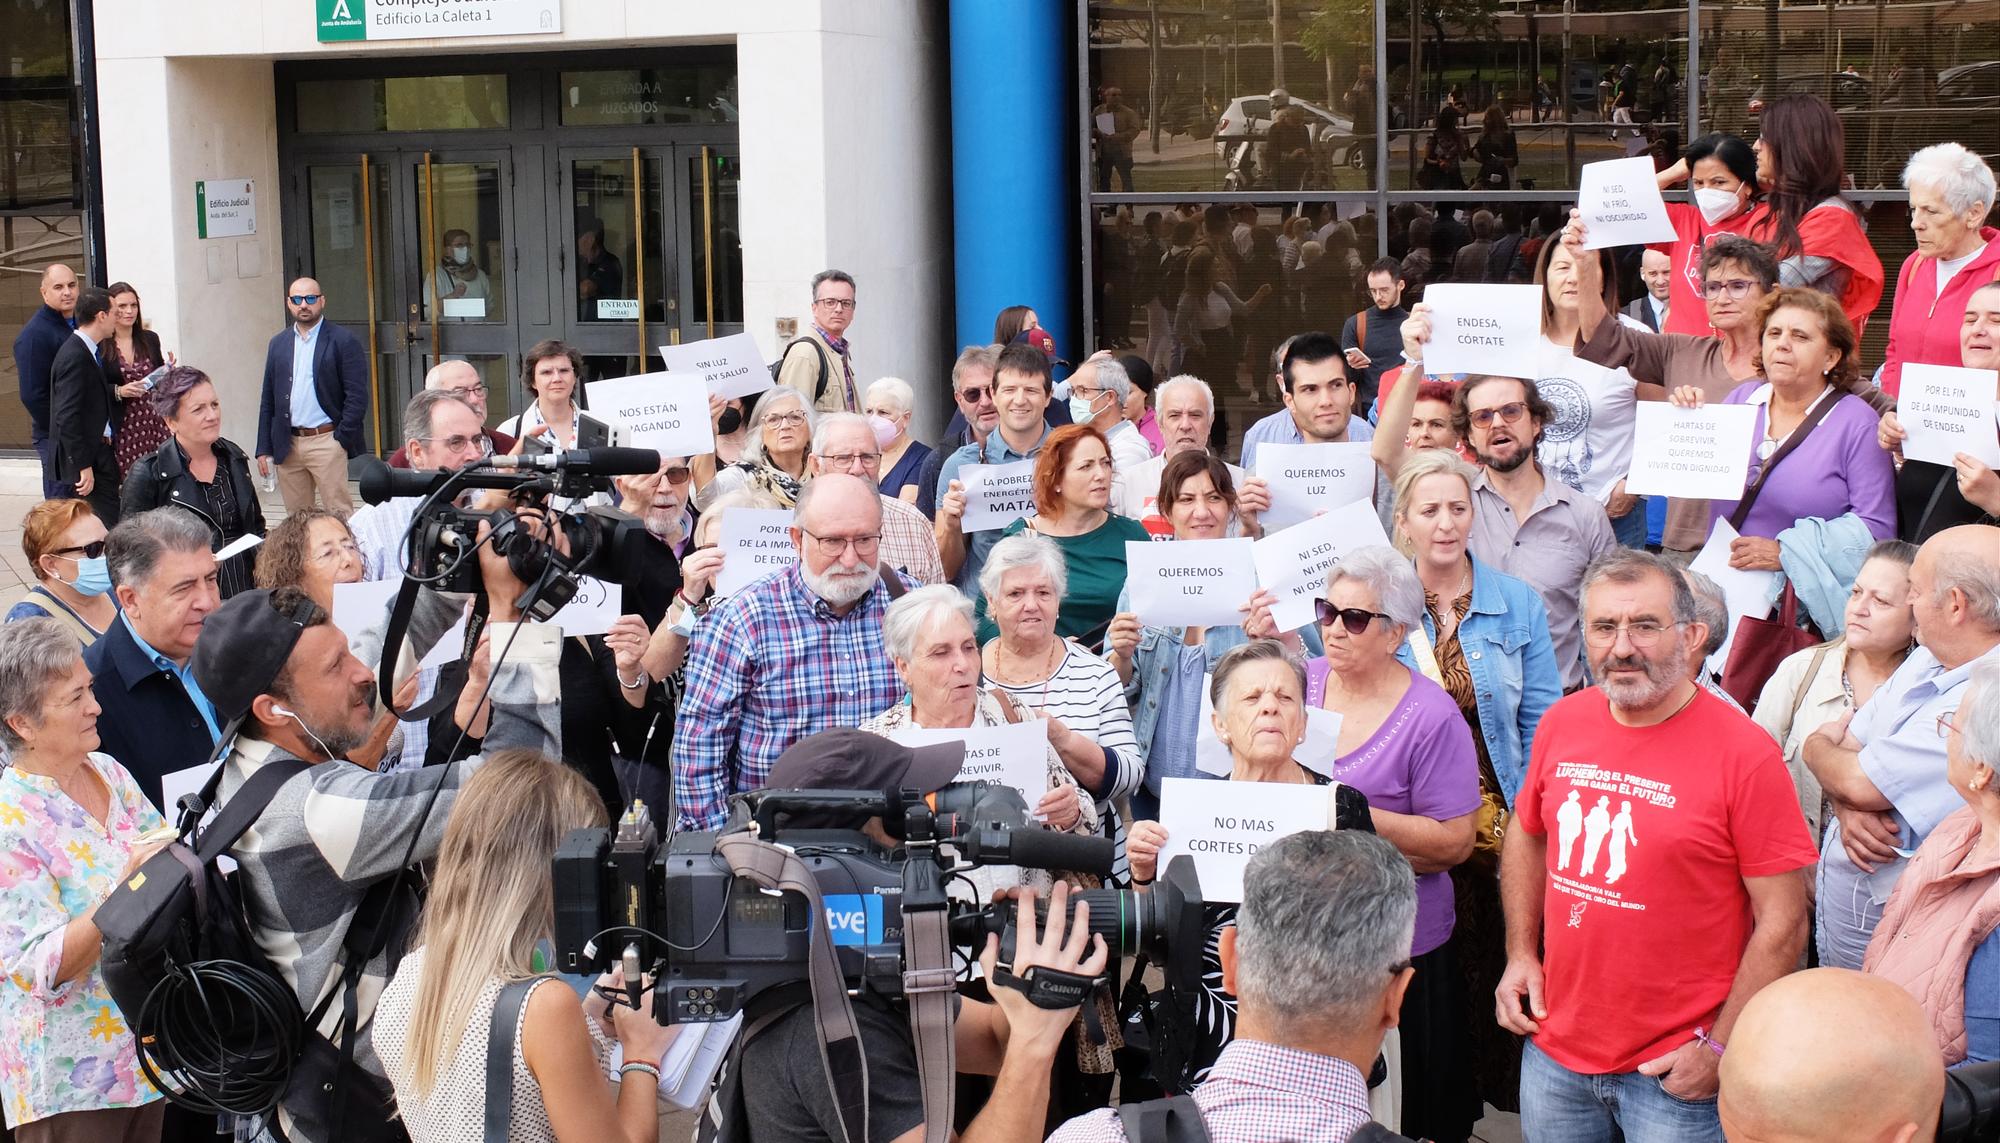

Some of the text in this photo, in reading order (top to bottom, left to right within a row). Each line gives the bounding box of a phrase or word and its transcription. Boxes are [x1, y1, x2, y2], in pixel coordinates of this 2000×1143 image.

[376, 9, 493, 25] Edificio La Caleta 1
[601, 82, 662, 96] ENTRADA A
[600, 101, 658, 114] JUZGADOS
[1605, 212, 1647, 222] OSCURIDAD
[1457, 317, 1502, 330] ENDESA,
[1457, 333, 1504, 346] CÓRTATE
[696, 358, 728, 369] SIN LUZ
[720, 367, 749, 380] SALUD
[1925, 385, 1966, 398] POR EL FIN
[619, 402, 678, 418] NOS ESTÁN
[1911, 401, 1981, 419] DE LA IMPUNIDAD
[1673, 421, 1717, 430] HARTAS DE
[1923, 419, 1965, 433] DE ENDESA
[1668, 448, 1714, 459] QUEREMOS
[1284, 468, 1346, 479] QUEREMOS
[1648, 460, 1730, 474] VIVIR CON DIGNIDAD
[983, 475, 1033, 486] LA POBREZ
[983, 487, 1035, 498] ENERGÉTIC
[1307, 485, 1326, 495] LUZ
[990, 500, 1036, 512] MATA
[760, 525, 781, 534] POR
[739, 539, 752, 547] DE
[755, 540, 767, 548] LA
[1298, 542, 1336, 561] NI SED,
[754, 554, 767, 564] DE
[1158, 567, 1224, 578] QUEREMOS
[1302, 566, 1315, 576] NI
[1183, 585, 1204, 595] LUZ
[1292, 585, 1305, 596] NI
[987, 747, 1001, 757] DE
[1555, 766, 1672, 793] LUCHEMOS EL PRESENTE
[1570, 778, 1589, 787] PARA
[1590, 780, 1618, 793] GANAR
[1618, 782, 1632, 796] EL
[1632, 786, 1677, 805] FUTURO
[1214, 816, 1275, 832] NO MAS
[1188, 839, 1259, 855] CORTES D
[825, 907, 866, 934] tve
[1039, 980, 1082, 995] Canon
